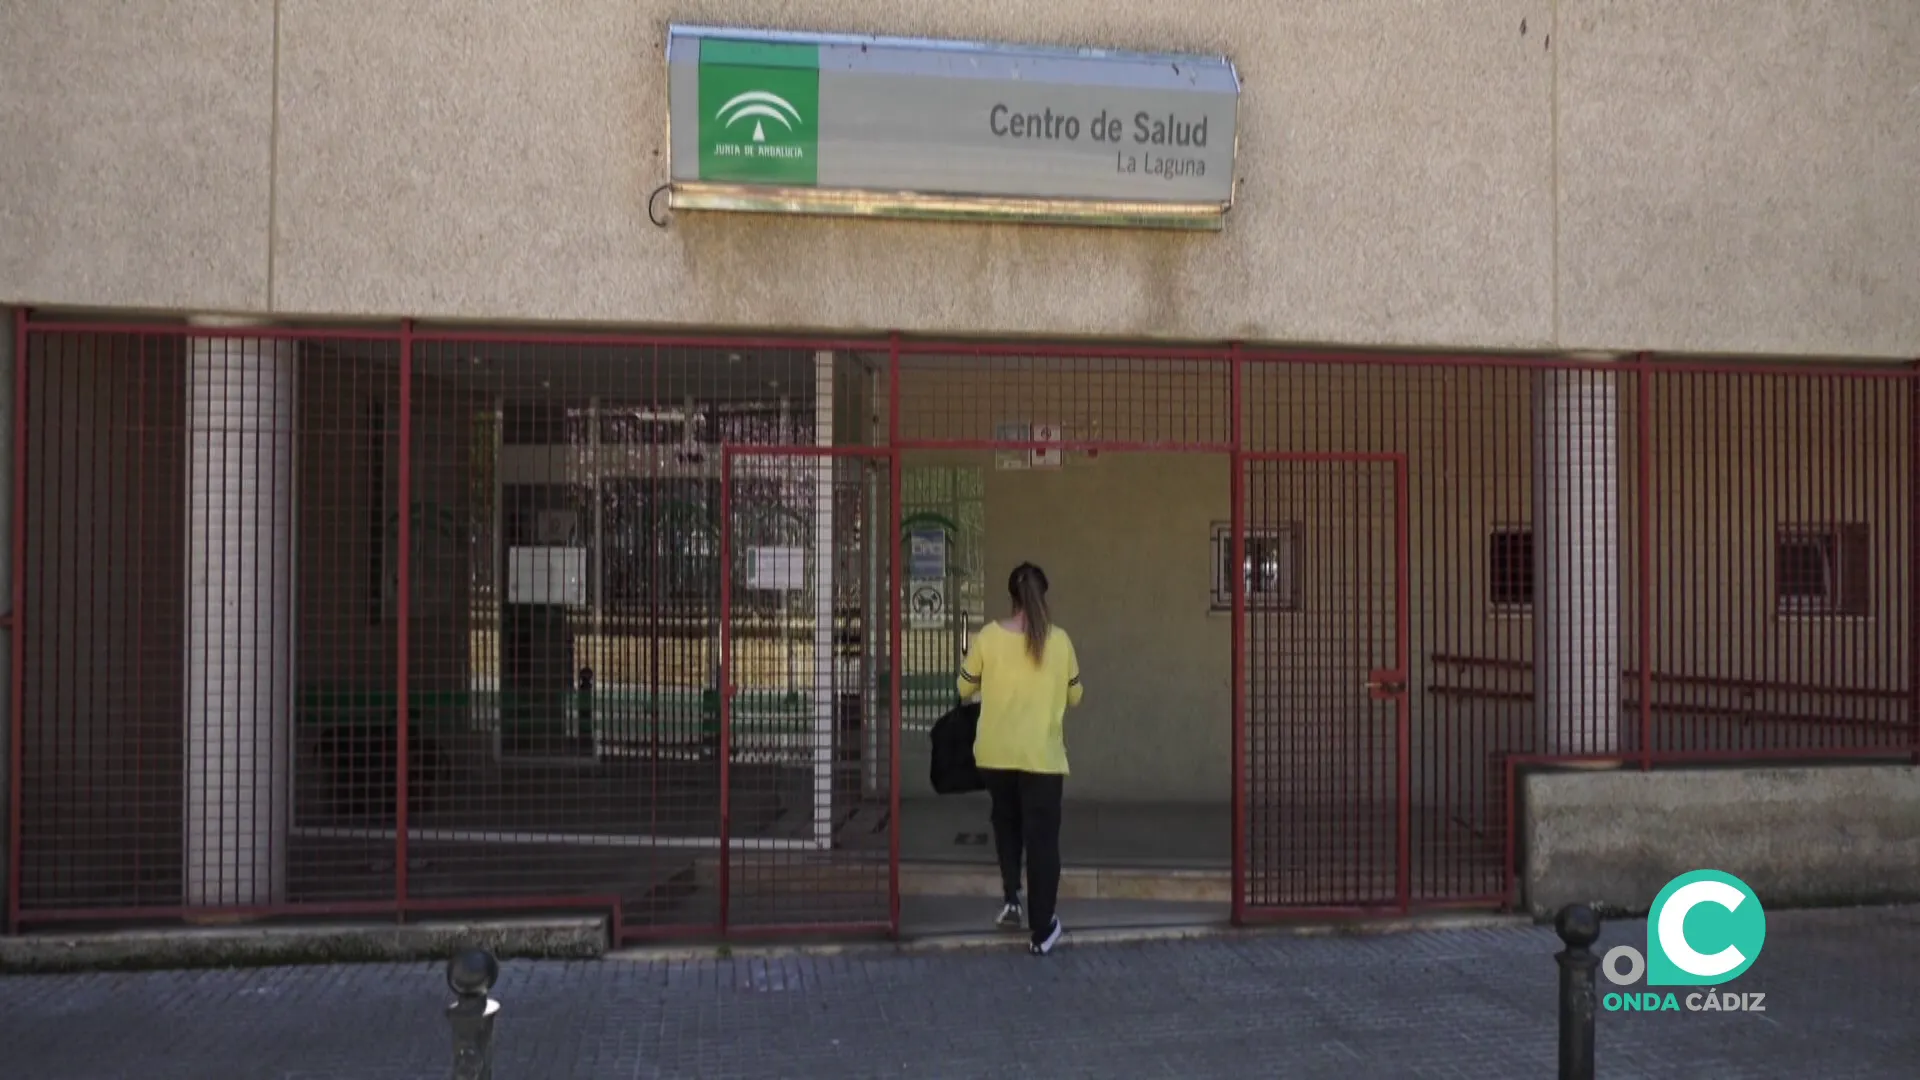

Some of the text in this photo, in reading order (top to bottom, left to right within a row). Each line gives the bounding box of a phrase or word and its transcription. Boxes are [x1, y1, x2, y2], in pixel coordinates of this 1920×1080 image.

[990, 103, 1208, 147] Centro de Salud
[714, 144, 741, 157] JUNTA
[744, 145, 753, 157] DE
[1117, 151, 1206, 180] La Laguna
